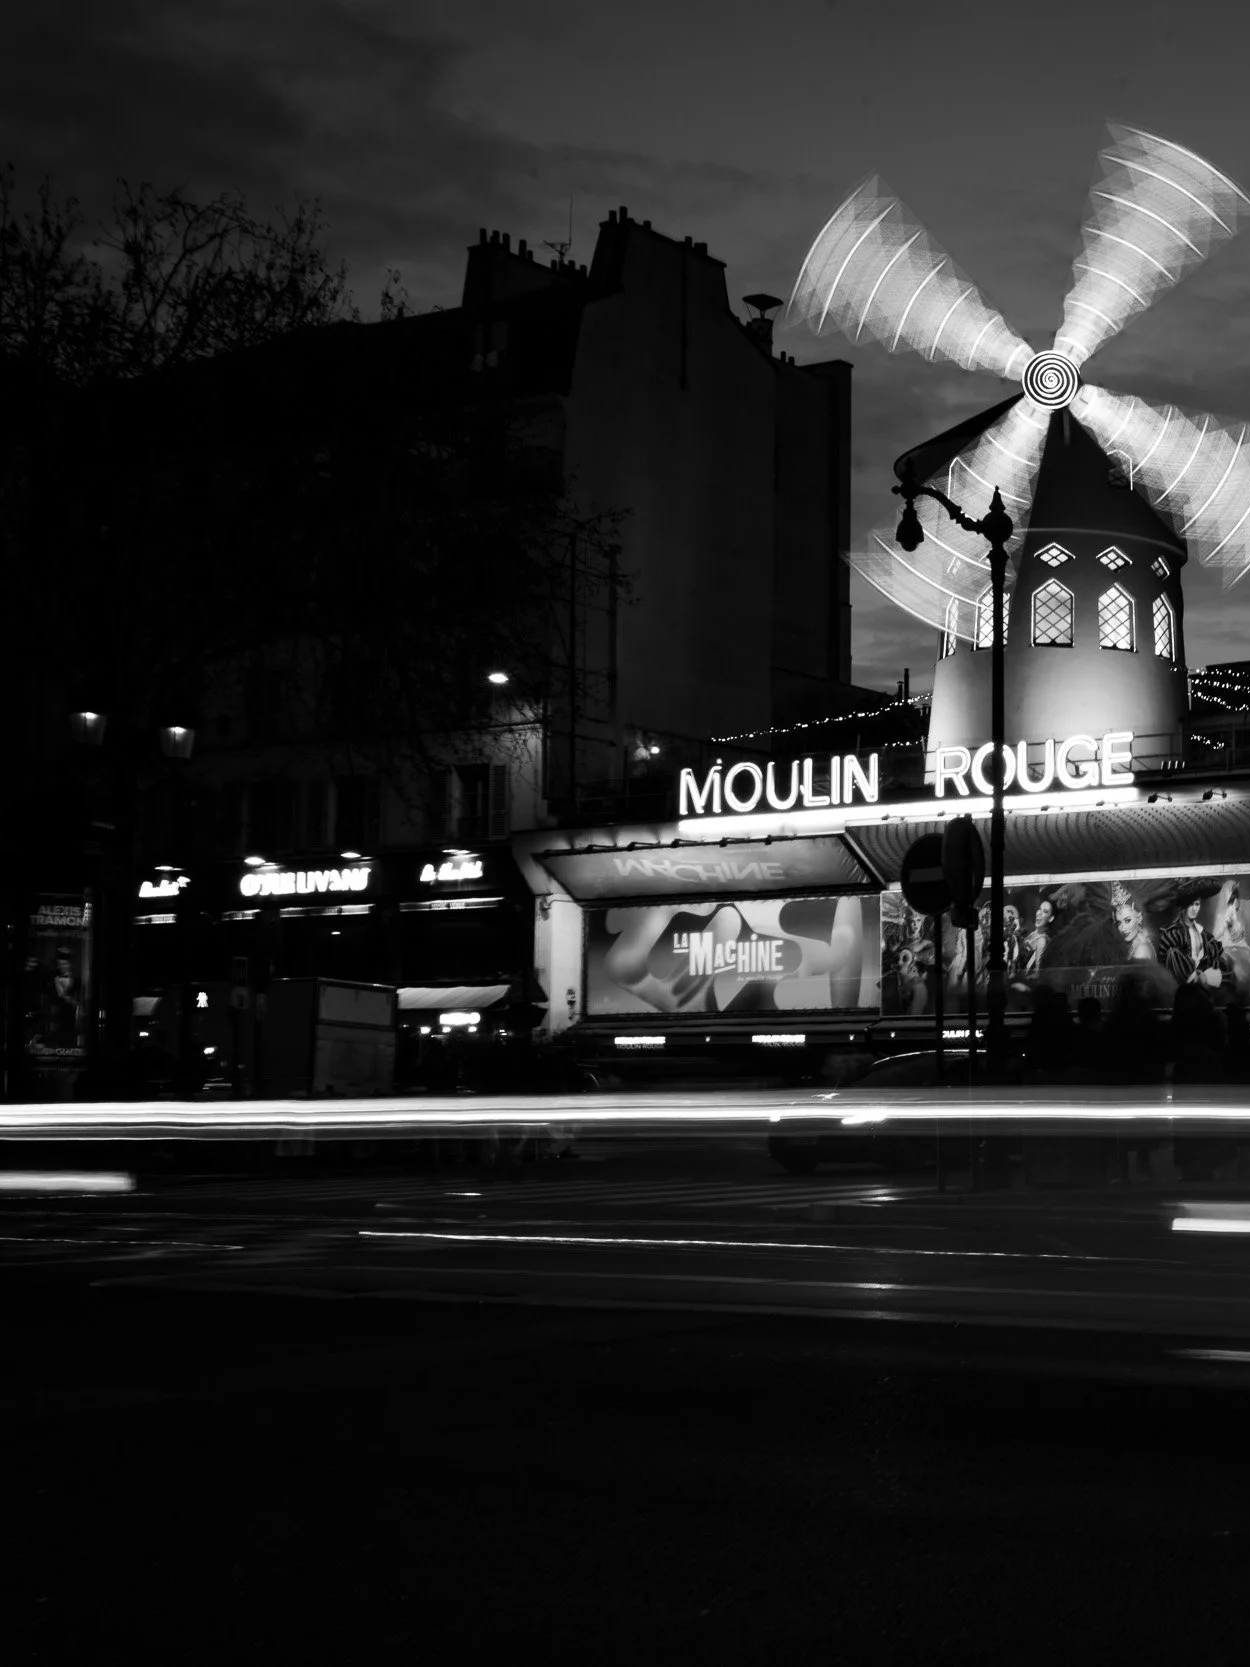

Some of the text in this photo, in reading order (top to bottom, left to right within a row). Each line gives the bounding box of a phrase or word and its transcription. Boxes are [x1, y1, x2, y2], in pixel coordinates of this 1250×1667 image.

[679, 731, 1135, 816] MOULIN ROUGE
[673, 932, 785, 976] LA MACHINE
